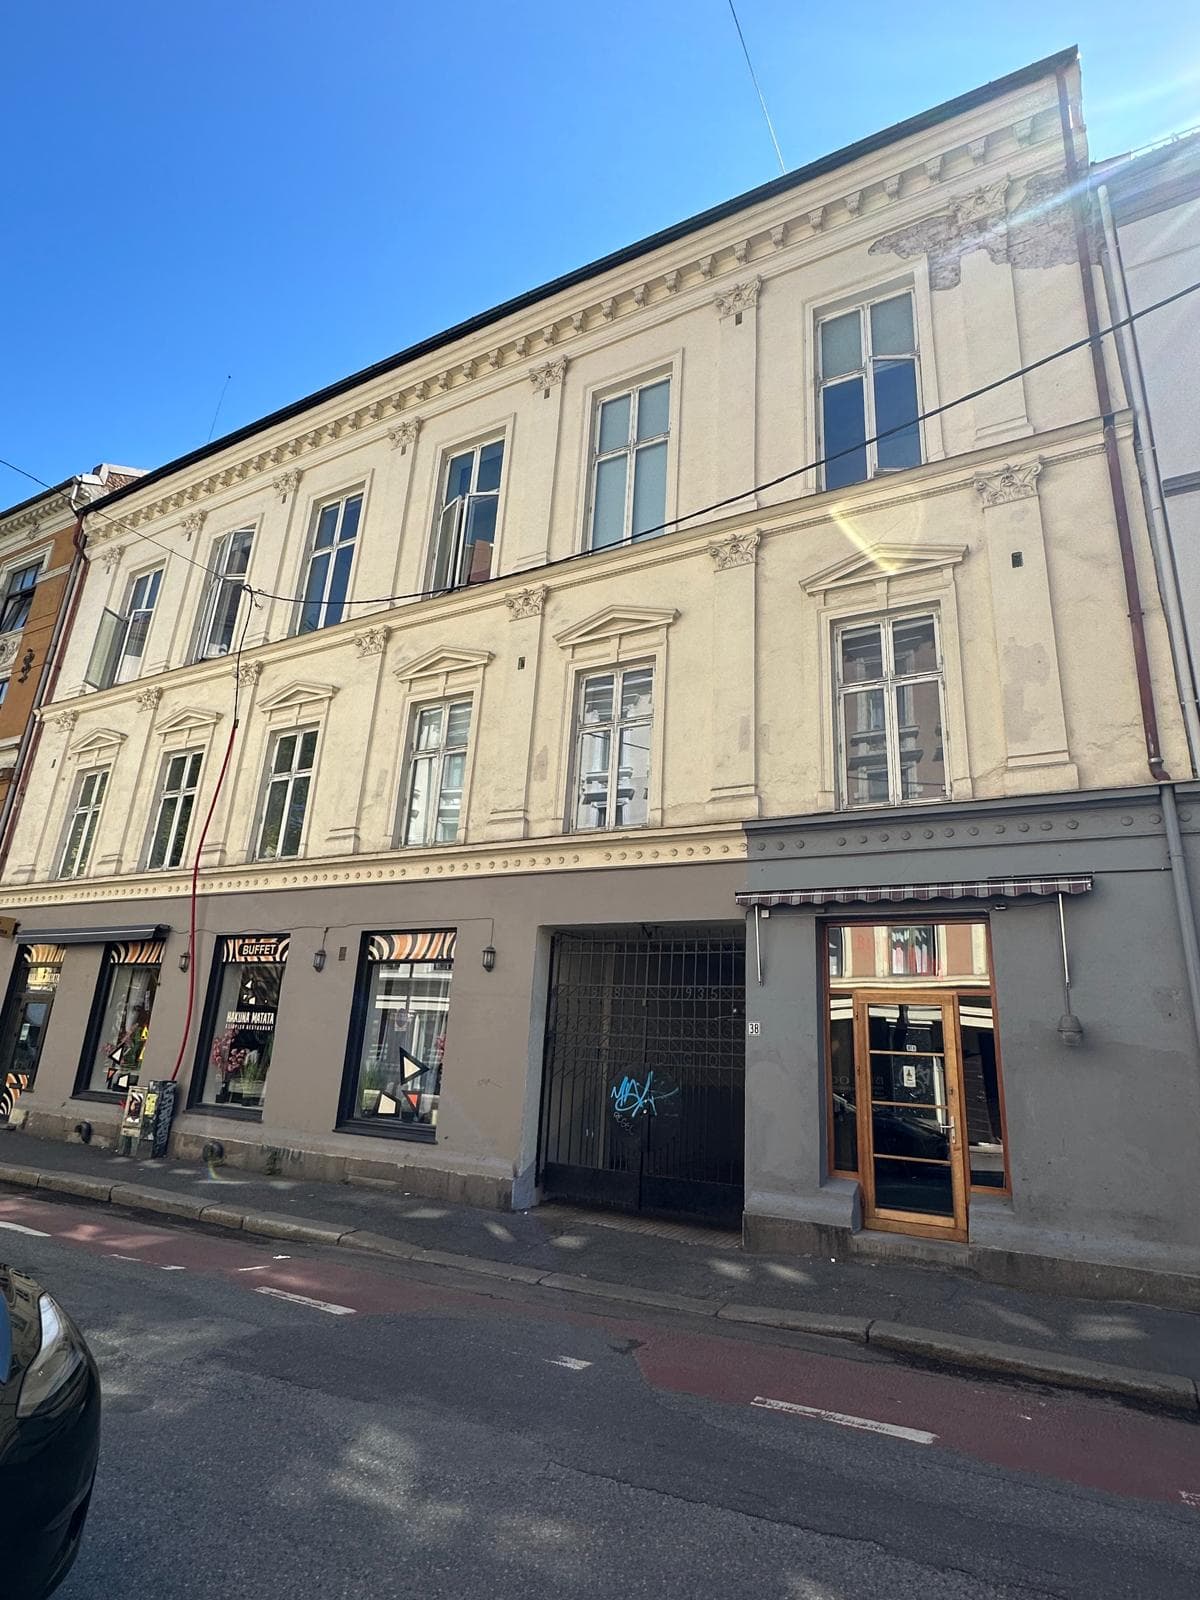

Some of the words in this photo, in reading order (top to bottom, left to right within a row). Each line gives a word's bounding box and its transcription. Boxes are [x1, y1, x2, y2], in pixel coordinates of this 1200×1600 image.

[242, 944, 276, 954] BUFFET
[226, 1011, 250, 1023] HAKUNA
[251, 1012, 275, 1024] MATATA
[749, 1023, 759, 1034] 38
